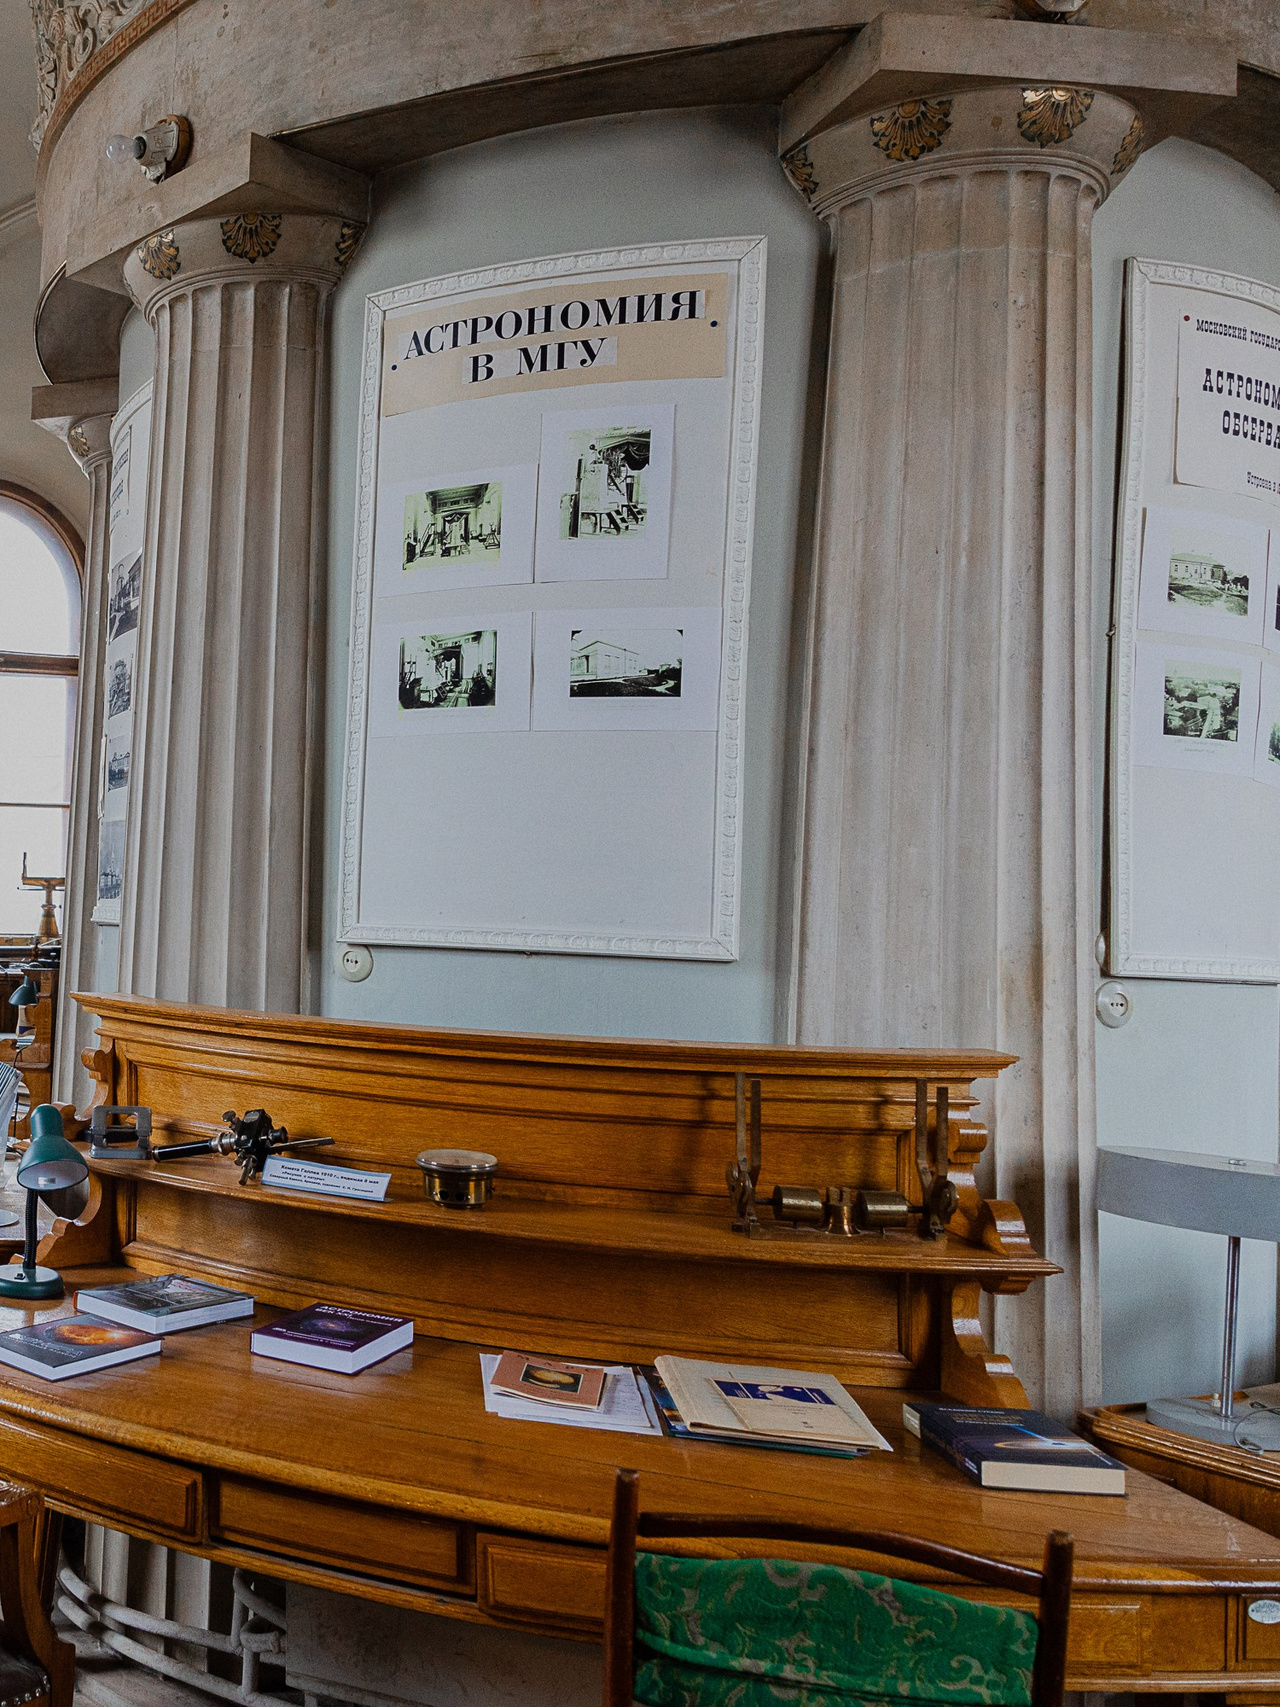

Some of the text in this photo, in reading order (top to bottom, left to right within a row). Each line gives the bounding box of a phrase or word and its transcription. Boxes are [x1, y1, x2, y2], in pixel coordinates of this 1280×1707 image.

[402, 289, 701, 360] АСТРОНОМИЯ
[1196, 318, 1248, 342] МОСКОВСКИЙ
[468, 337, 608, 384] В МГУ
[1202, 367, 1280, 411] АСТРОНОМ
[319, 1305, 404, 1323] АСТРОНОМИЯ
